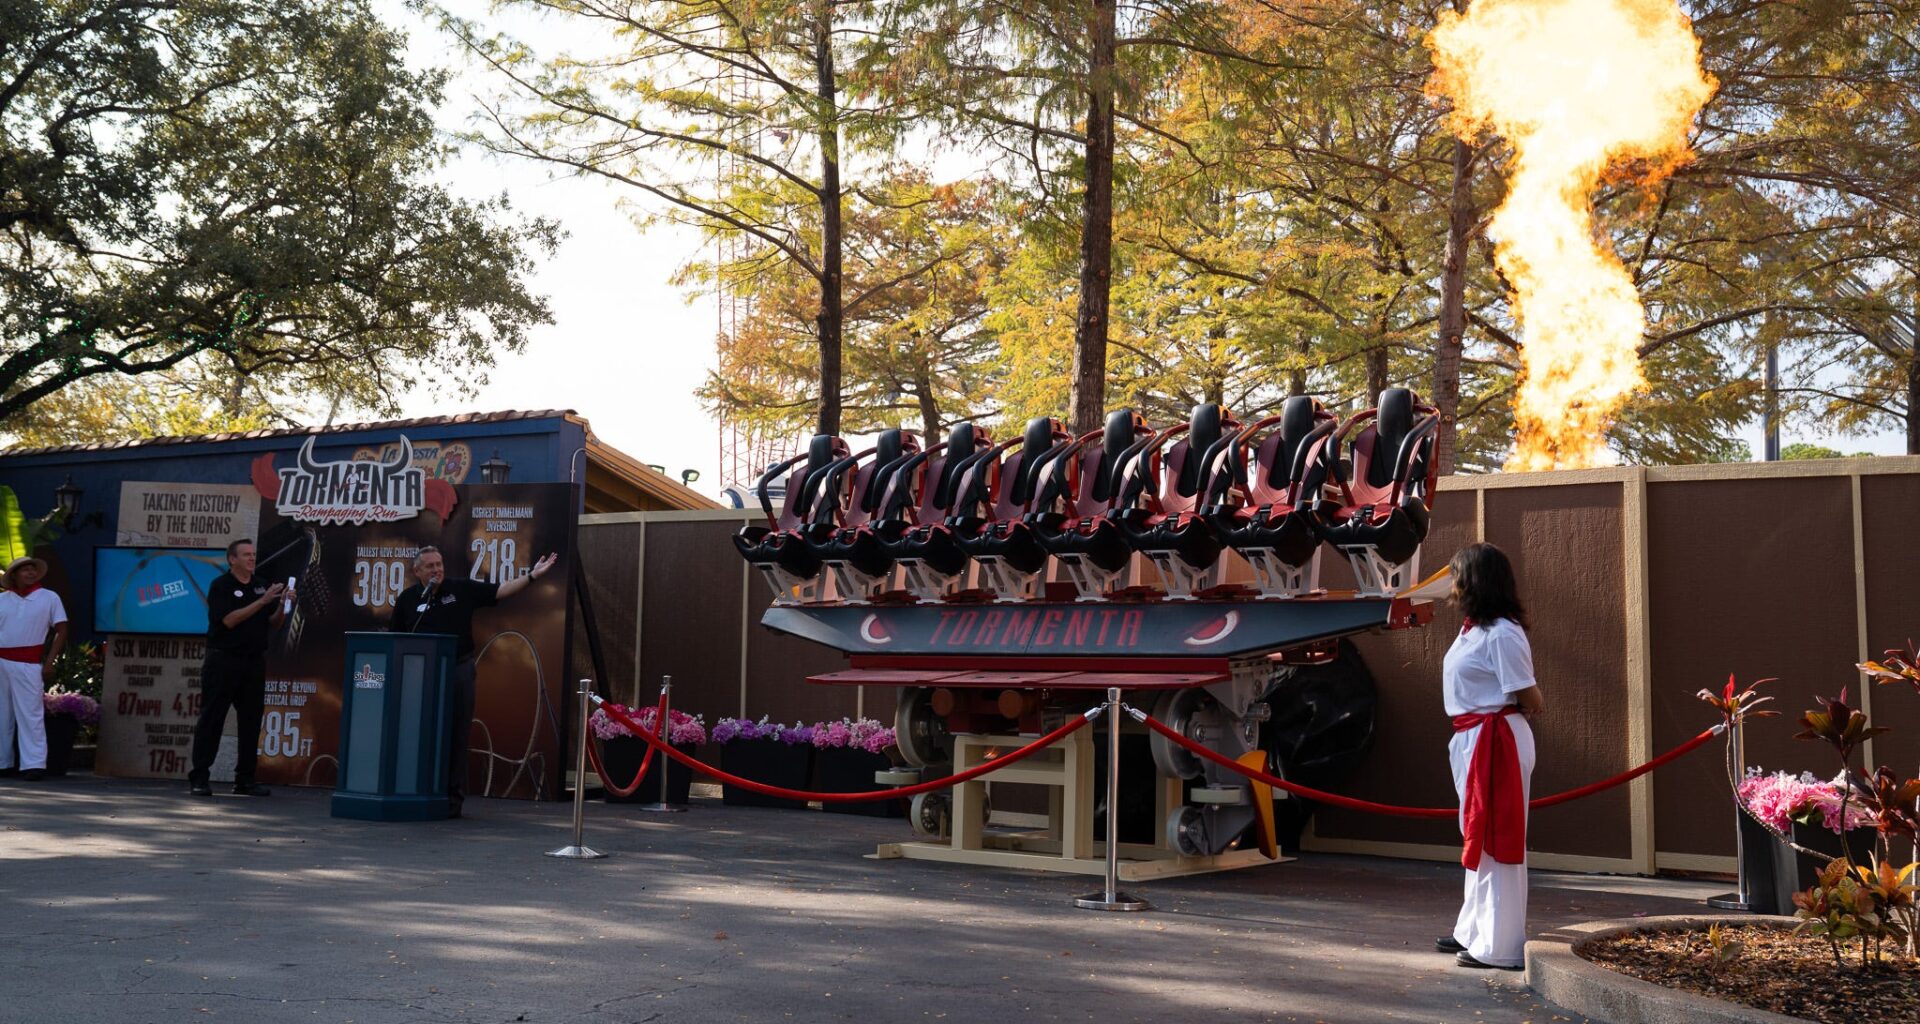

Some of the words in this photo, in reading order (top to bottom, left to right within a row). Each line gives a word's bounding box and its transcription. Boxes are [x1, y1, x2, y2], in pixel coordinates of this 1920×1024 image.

[278, 462, 422, 507] TORMENTA
[142, 493, 187, 512] TAKING
[189, 494, 241, 513] HISTORY
[298, 504, 367, 525] Rampaging
[367, 505, 401, 519] Run
[496, 506, 534, 518] IMMELMANN
[147, 514, 163, 533] BY
[166, 515, 187, 533] THE
[190, 516, 232, 535] HORNS
[486, 520, 518, 531] INVERSION
[168, 536, 192, 547] COMING
[357, 546, 378, 558] TALLEST
[163, 580, 185, 595] FEET
[929, 608, 1145, 647] TORMENTA
[113, 639, 135, 658] SIX
[139, 640, 180, 659] WORLD
[264, 694, 288, 706] ERTICAL
